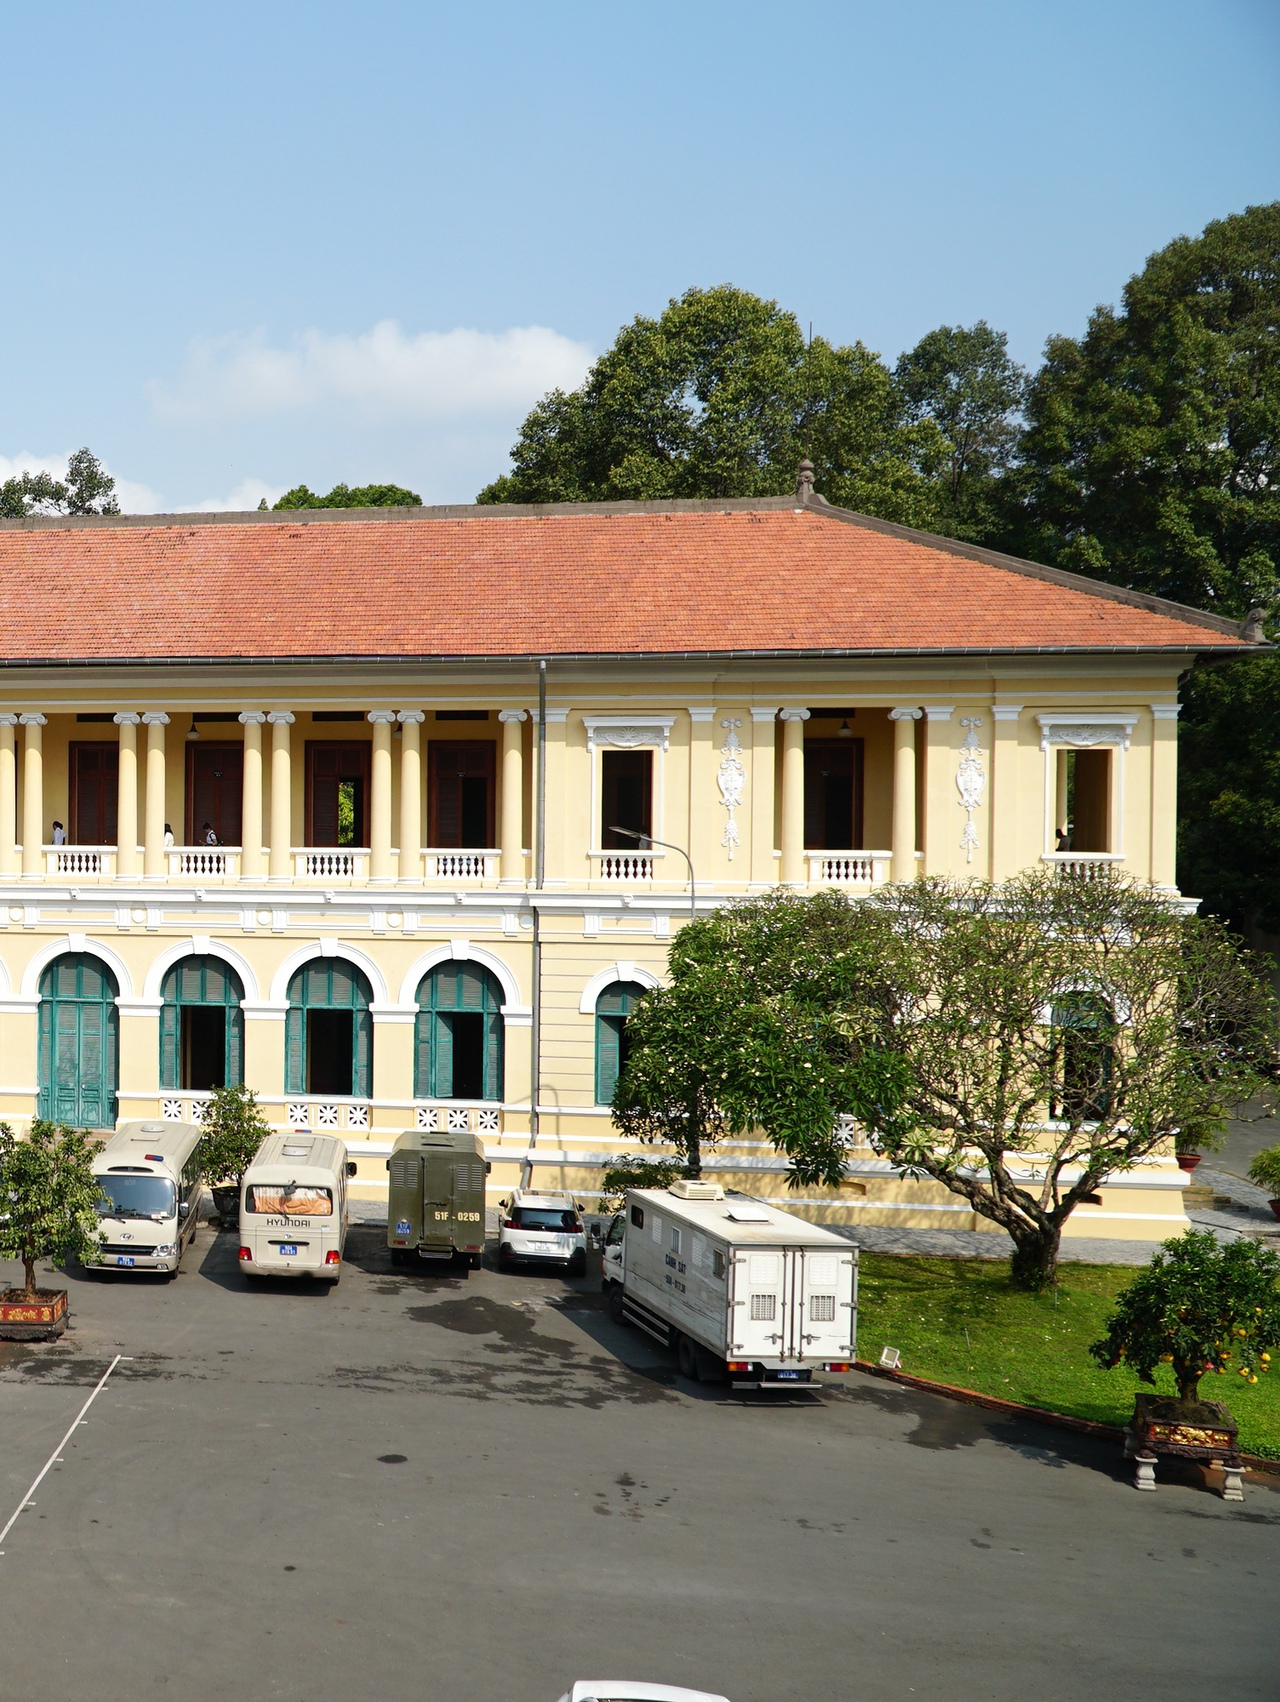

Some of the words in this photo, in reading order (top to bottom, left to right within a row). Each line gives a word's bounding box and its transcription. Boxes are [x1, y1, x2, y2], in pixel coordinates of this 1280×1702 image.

[434, 1212, 449, 1220] 51F
[457, 1212, 480, 1222] 0259
[266, 1218, 310, 1228] HYUNDAI
